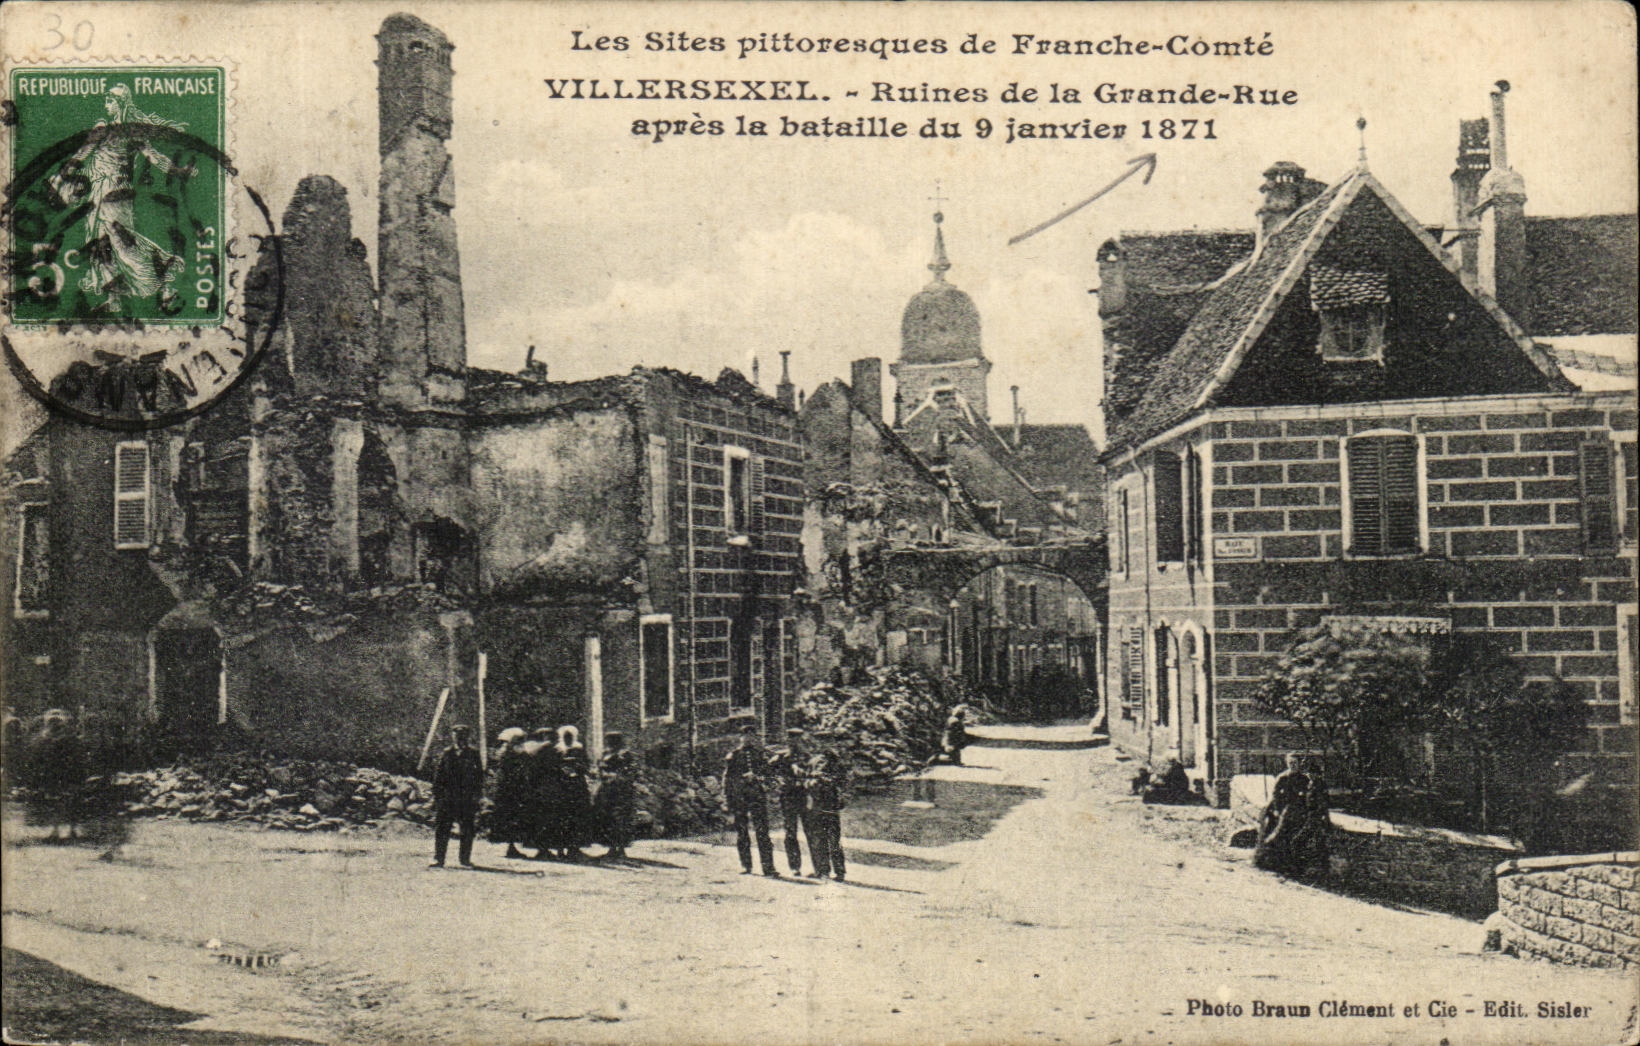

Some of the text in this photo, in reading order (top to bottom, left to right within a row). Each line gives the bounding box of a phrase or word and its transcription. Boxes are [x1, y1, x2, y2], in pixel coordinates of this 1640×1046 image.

[42, 14, 95, 51] 30
[134, 77, 215, 97] FRANÇAISE
[196, 225, 215, 309] POSTES
